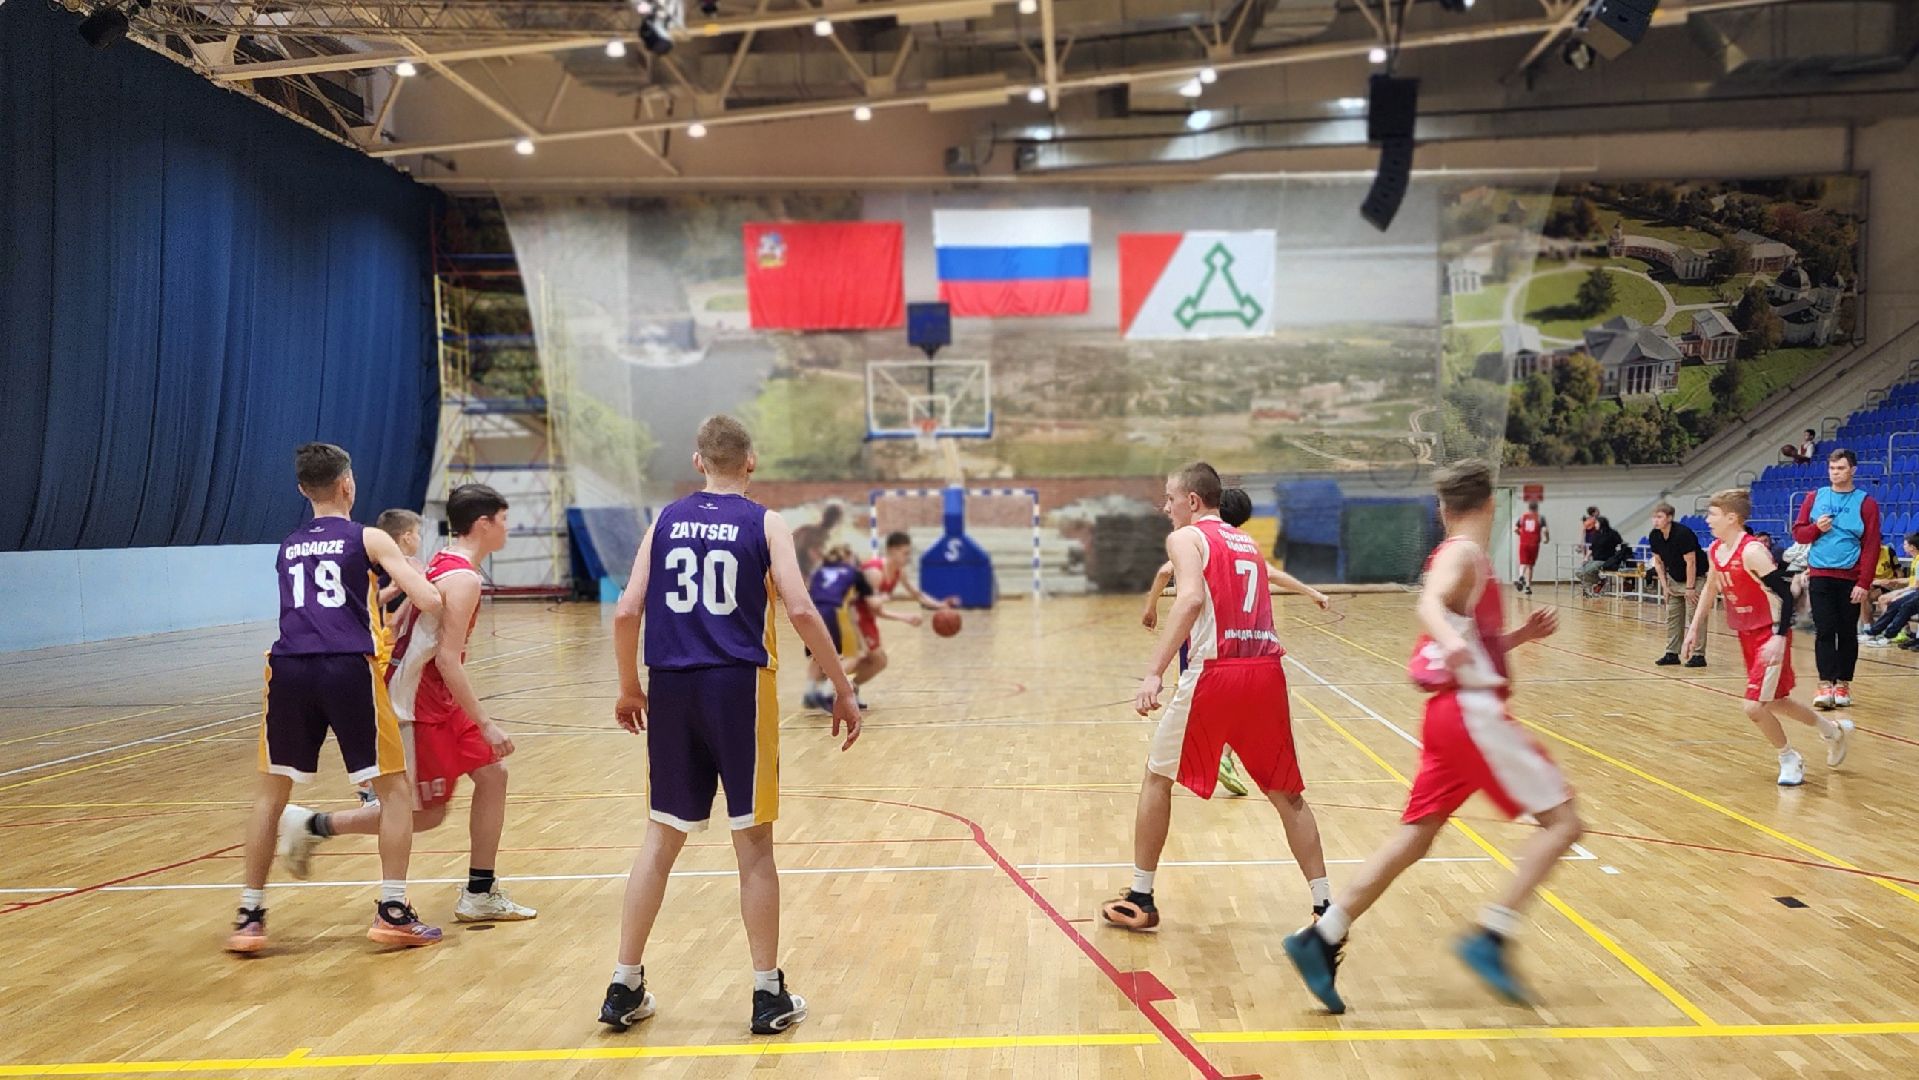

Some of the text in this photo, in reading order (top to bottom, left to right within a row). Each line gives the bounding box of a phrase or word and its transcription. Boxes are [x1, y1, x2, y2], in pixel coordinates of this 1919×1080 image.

[670, 522, 739, 541] ZAYTSEV
[288, 560, 347, 608] 19
[665, 547, 739, 615] 30
[1235, 559, 1258, 613] 7
